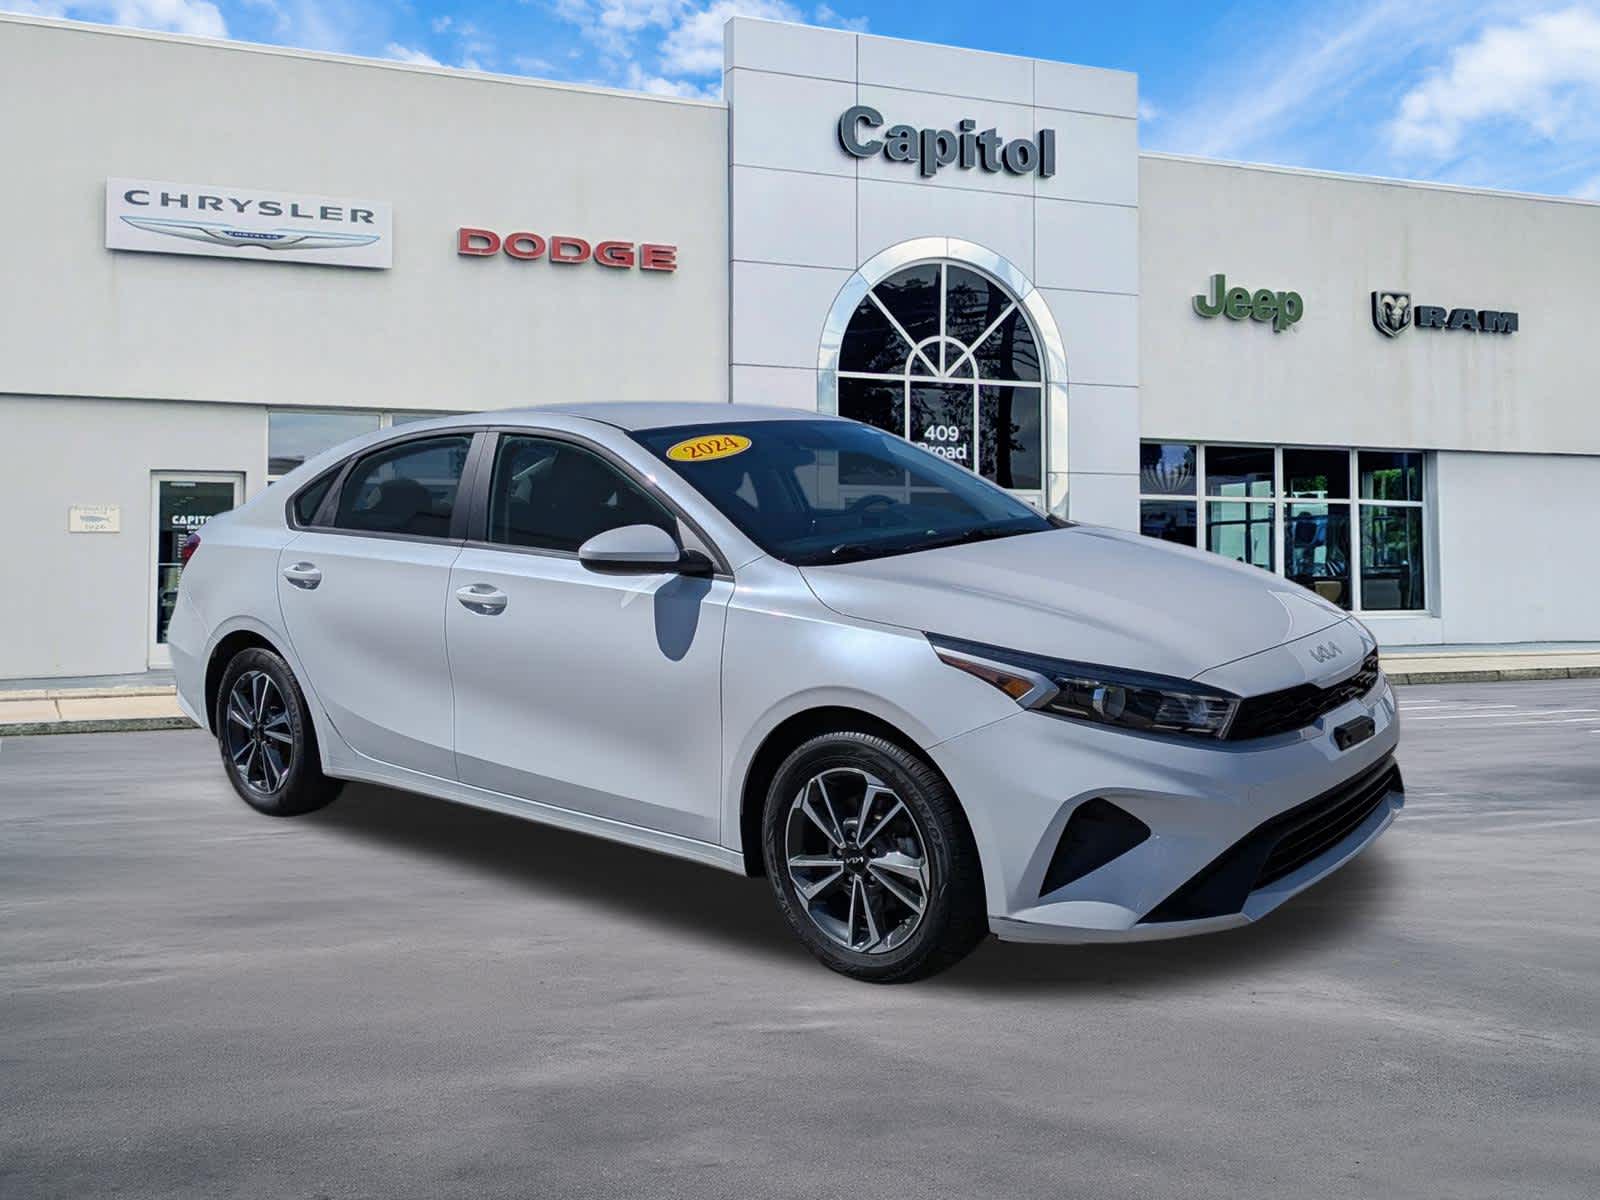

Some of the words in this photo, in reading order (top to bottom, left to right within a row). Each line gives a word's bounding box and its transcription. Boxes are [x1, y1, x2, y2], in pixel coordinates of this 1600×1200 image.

[838, 105, 1056, 177] Capitol
[123, 189, 375, 224] CHRYSLER
[457, 227, 678, 272] DODGE
[1192, 273, 1304, 333] Jeep
[1414, 305, 1519, 334] RAM
[683, 436, 739, 459] 2024
[924, 424, 959, 441] 409
